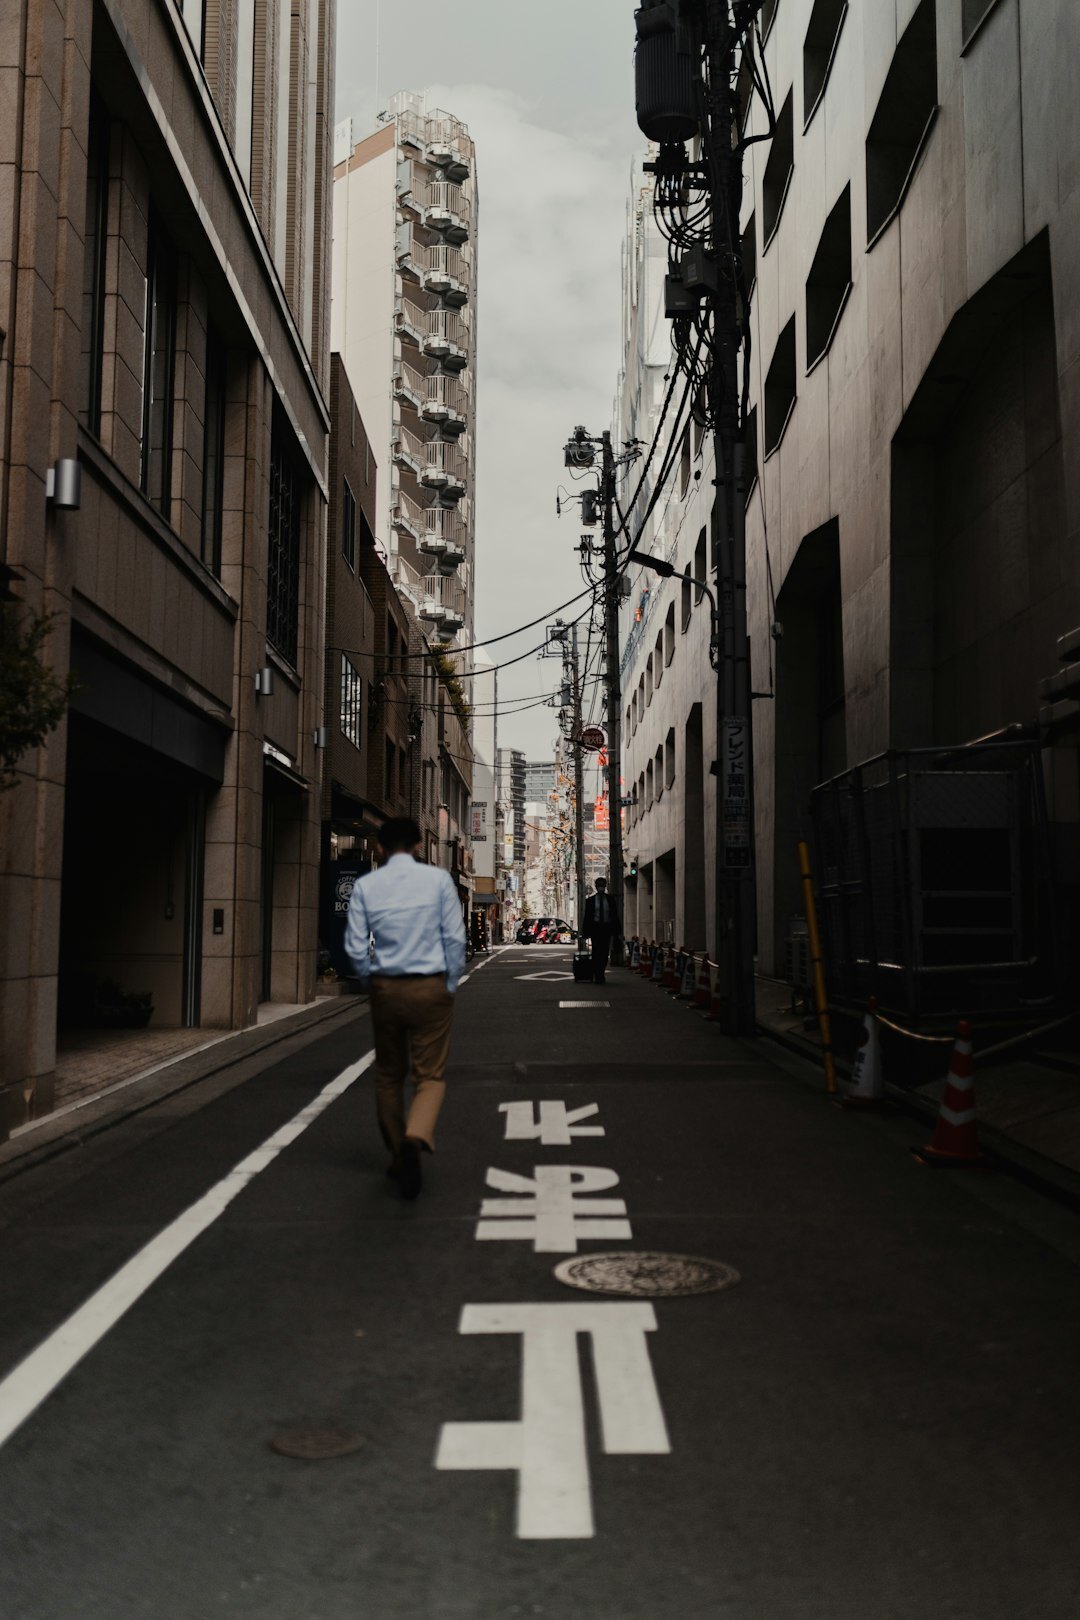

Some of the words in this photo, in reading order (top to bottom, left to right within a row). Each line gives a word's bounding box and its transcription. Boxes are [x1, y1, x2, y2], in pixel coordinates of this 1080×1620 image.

[727, 726, 745, 798] フレンド薬局
[435, 1100, 672, 1539] 止まれ
